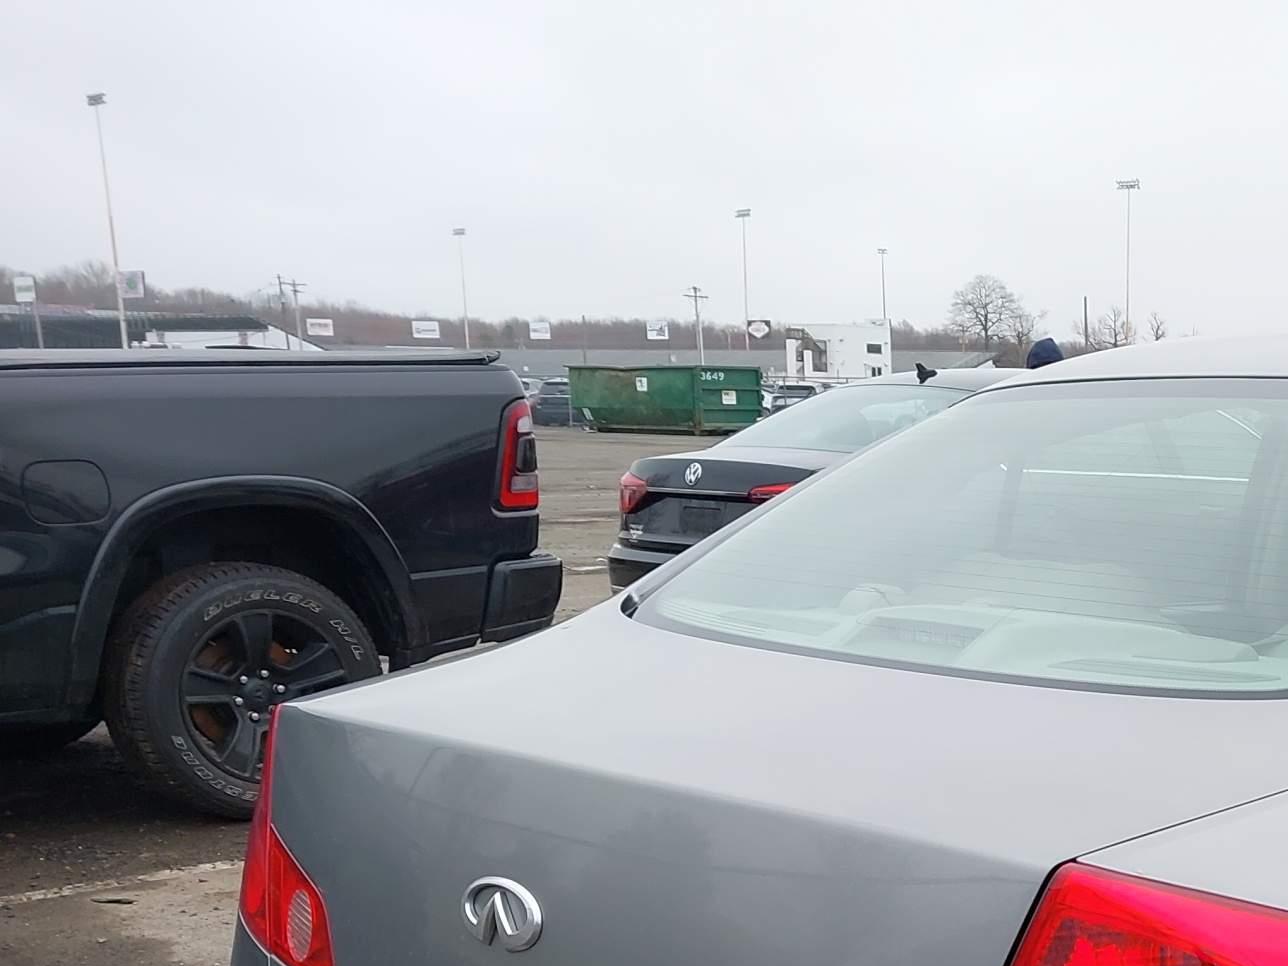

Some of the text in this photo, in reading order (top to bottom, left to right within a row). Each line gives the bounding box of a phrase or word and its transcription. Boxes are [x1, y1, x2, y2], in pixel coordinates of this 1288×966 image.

[699, 370, 725, 382] 3649
[203, 588, 366, 662] DUELER H/L
[170, 734, 261, 803] ESTONE
